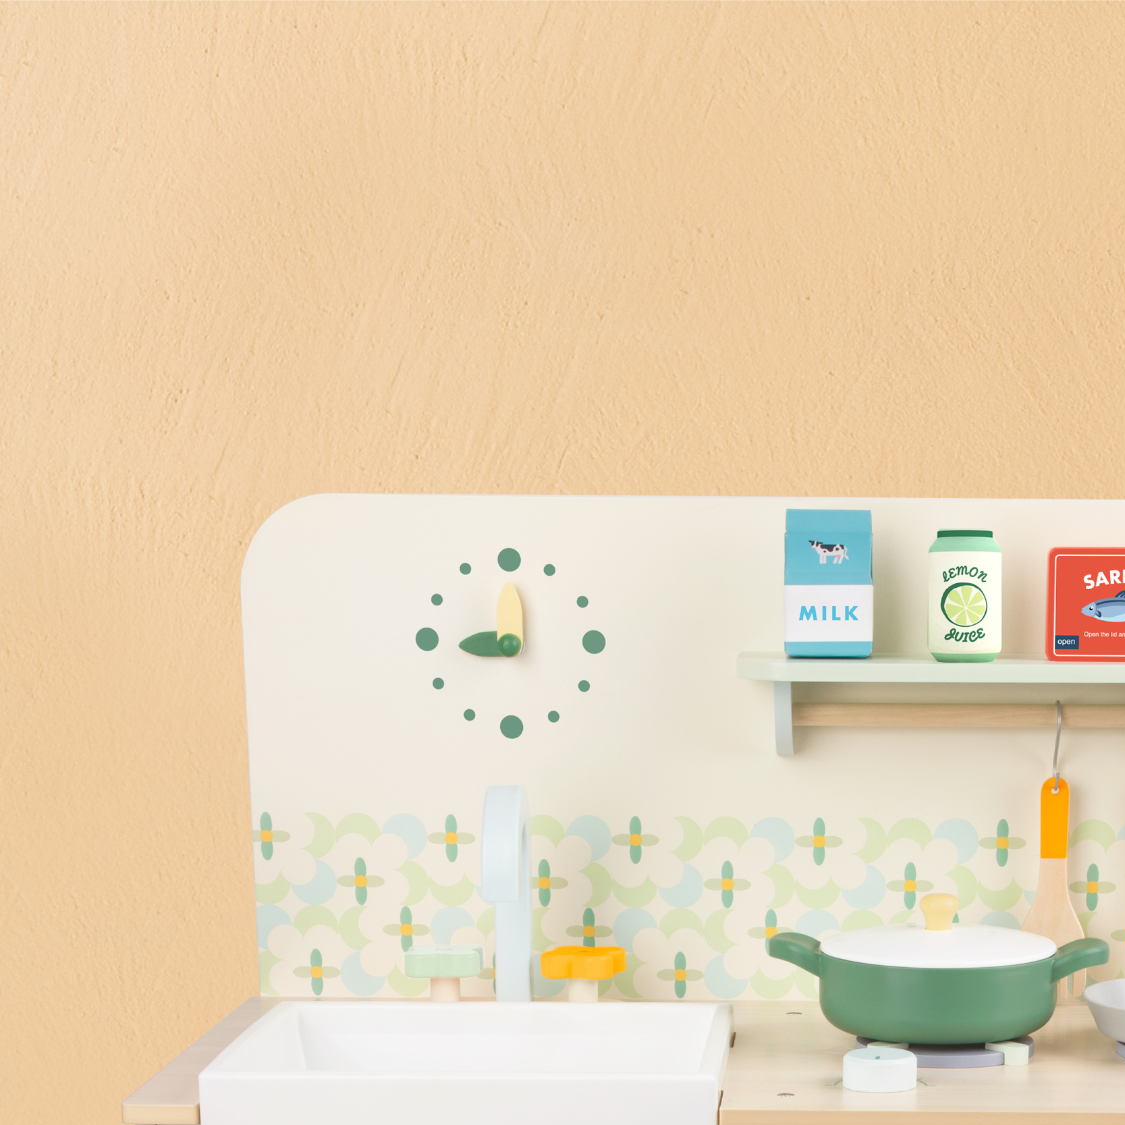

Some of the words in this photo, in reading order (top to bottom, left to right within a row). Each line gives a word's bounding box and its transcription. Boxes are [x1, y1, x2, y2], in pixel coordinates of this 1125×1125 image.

[942, 565, 988, 583] LEMON
[799, 605, 859, 621] MILK
[944, 627, 986, 643] JUICE
[1057, 638, 1076, 646] open
[1083, 631, 1100, 639] Open
